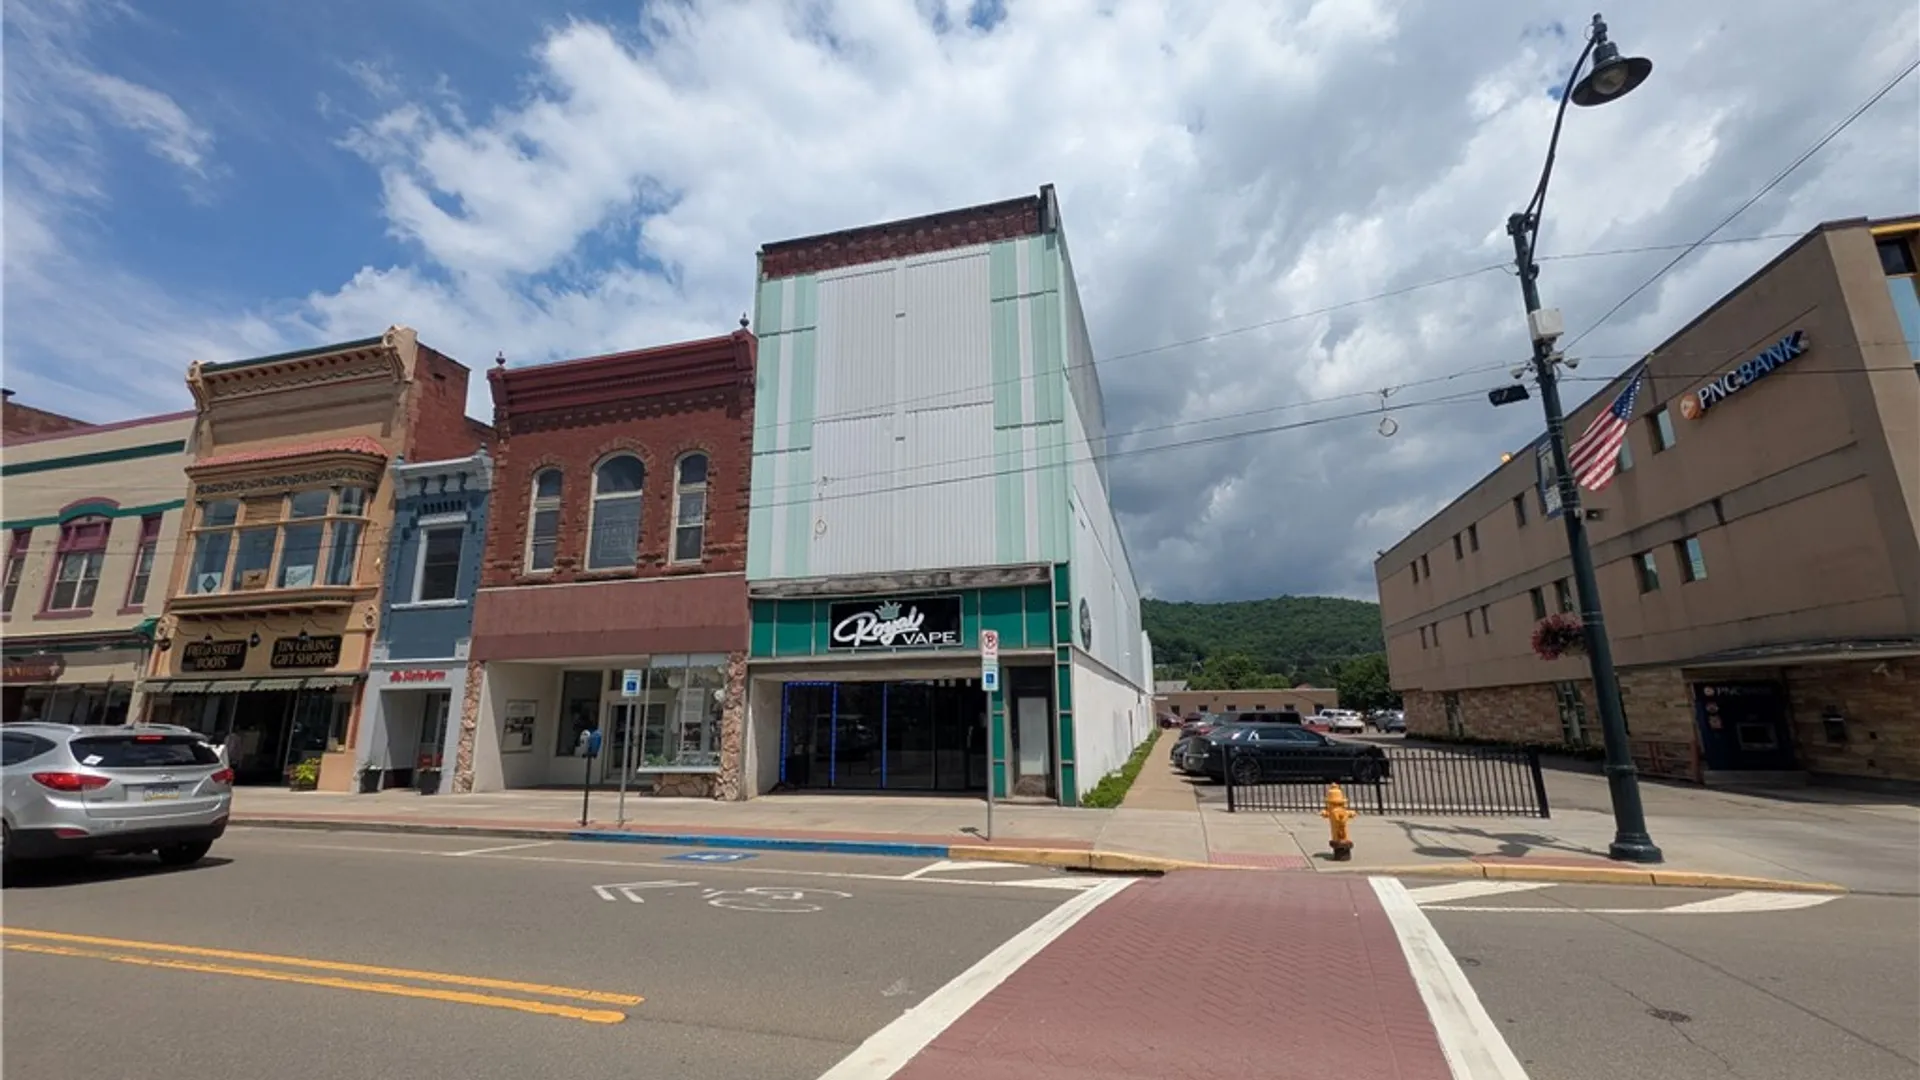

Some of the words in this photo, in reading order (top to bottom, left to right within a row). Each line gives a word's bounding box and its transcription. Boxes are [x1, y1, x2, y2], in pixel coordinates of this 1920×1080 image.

[1698, 370, 1741, 409] PNC
[1740, 332, 1802, 384] BANK
[833, 606, 925, 647] Royal
[902, 631, 956, 645] VAPE
[273, 654, 295, 665] GIFT
[295, 651, 336, 665] SHOPPE
